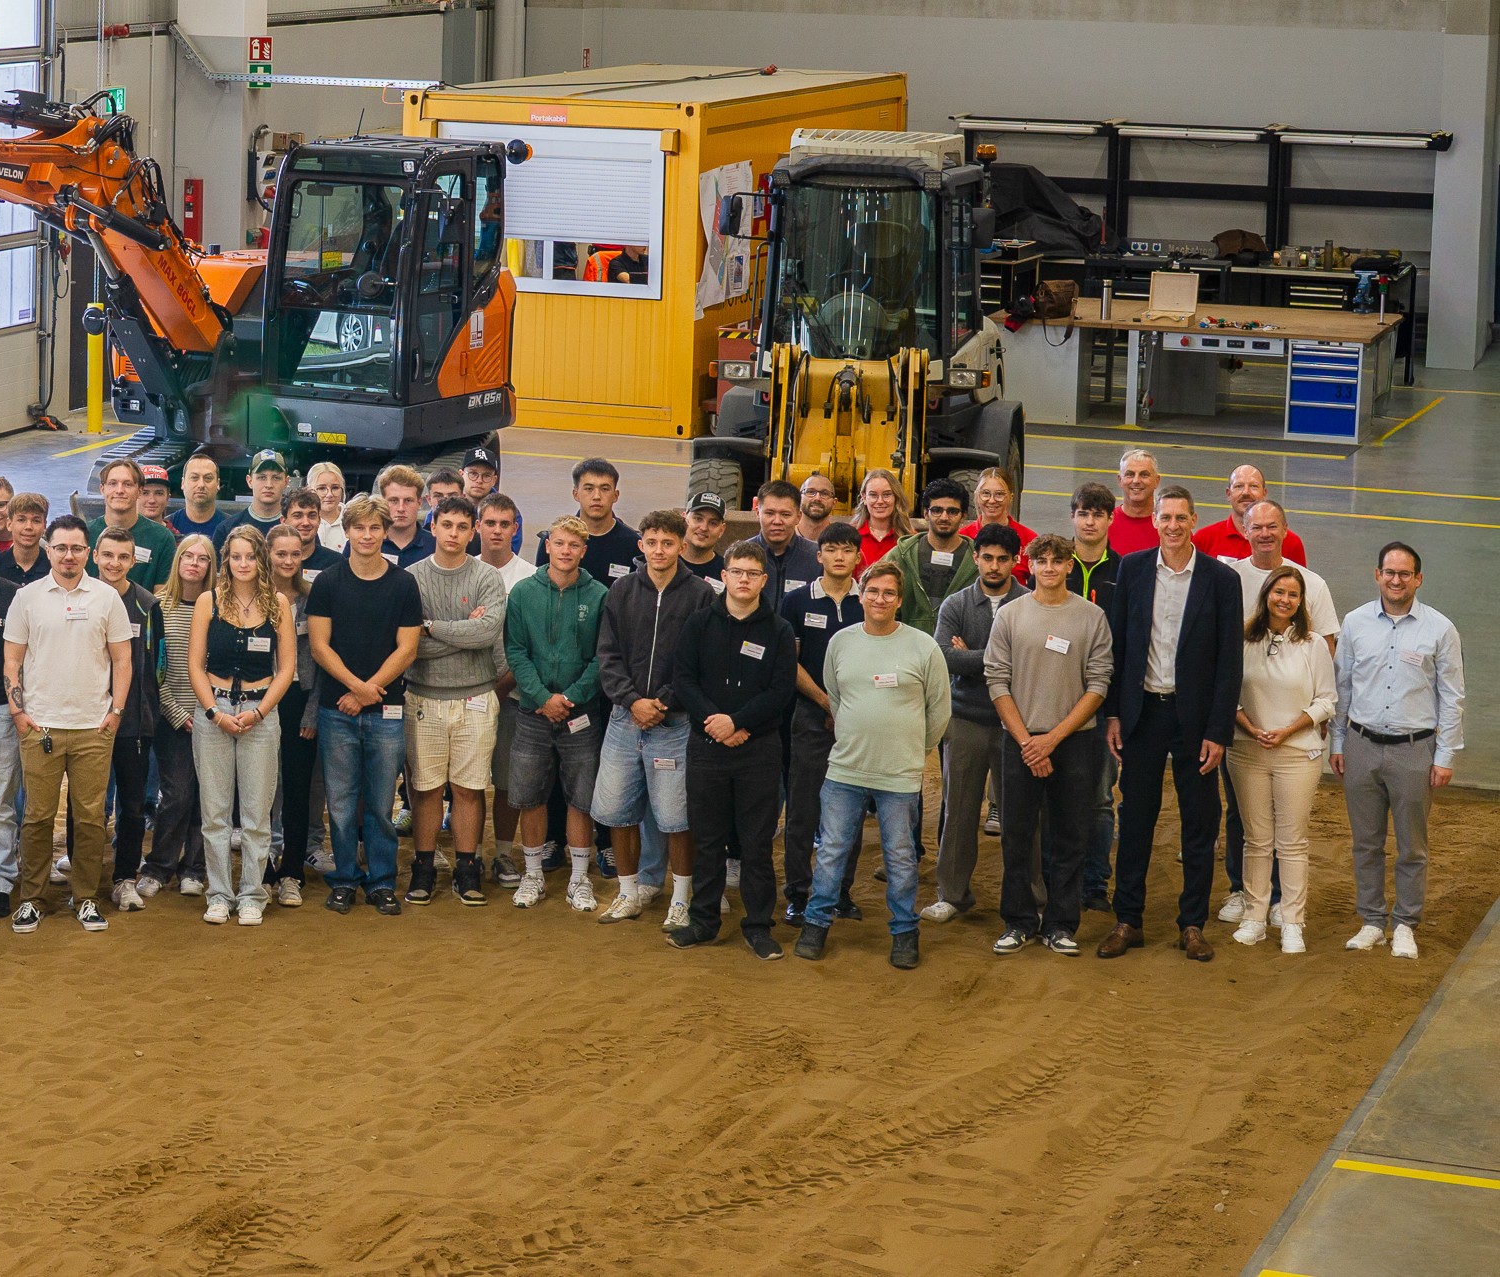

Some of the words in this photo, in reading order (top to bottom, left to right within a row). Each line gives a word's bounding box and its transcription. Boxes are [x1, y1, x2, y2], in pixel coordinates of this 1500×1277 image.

[530, 113, 567, 123] Portakabin
[157, 254, 178, 286] MAX
[176, 283, 197, 318] BÖGL
[1335, 385, 1352, 400] 3.3
